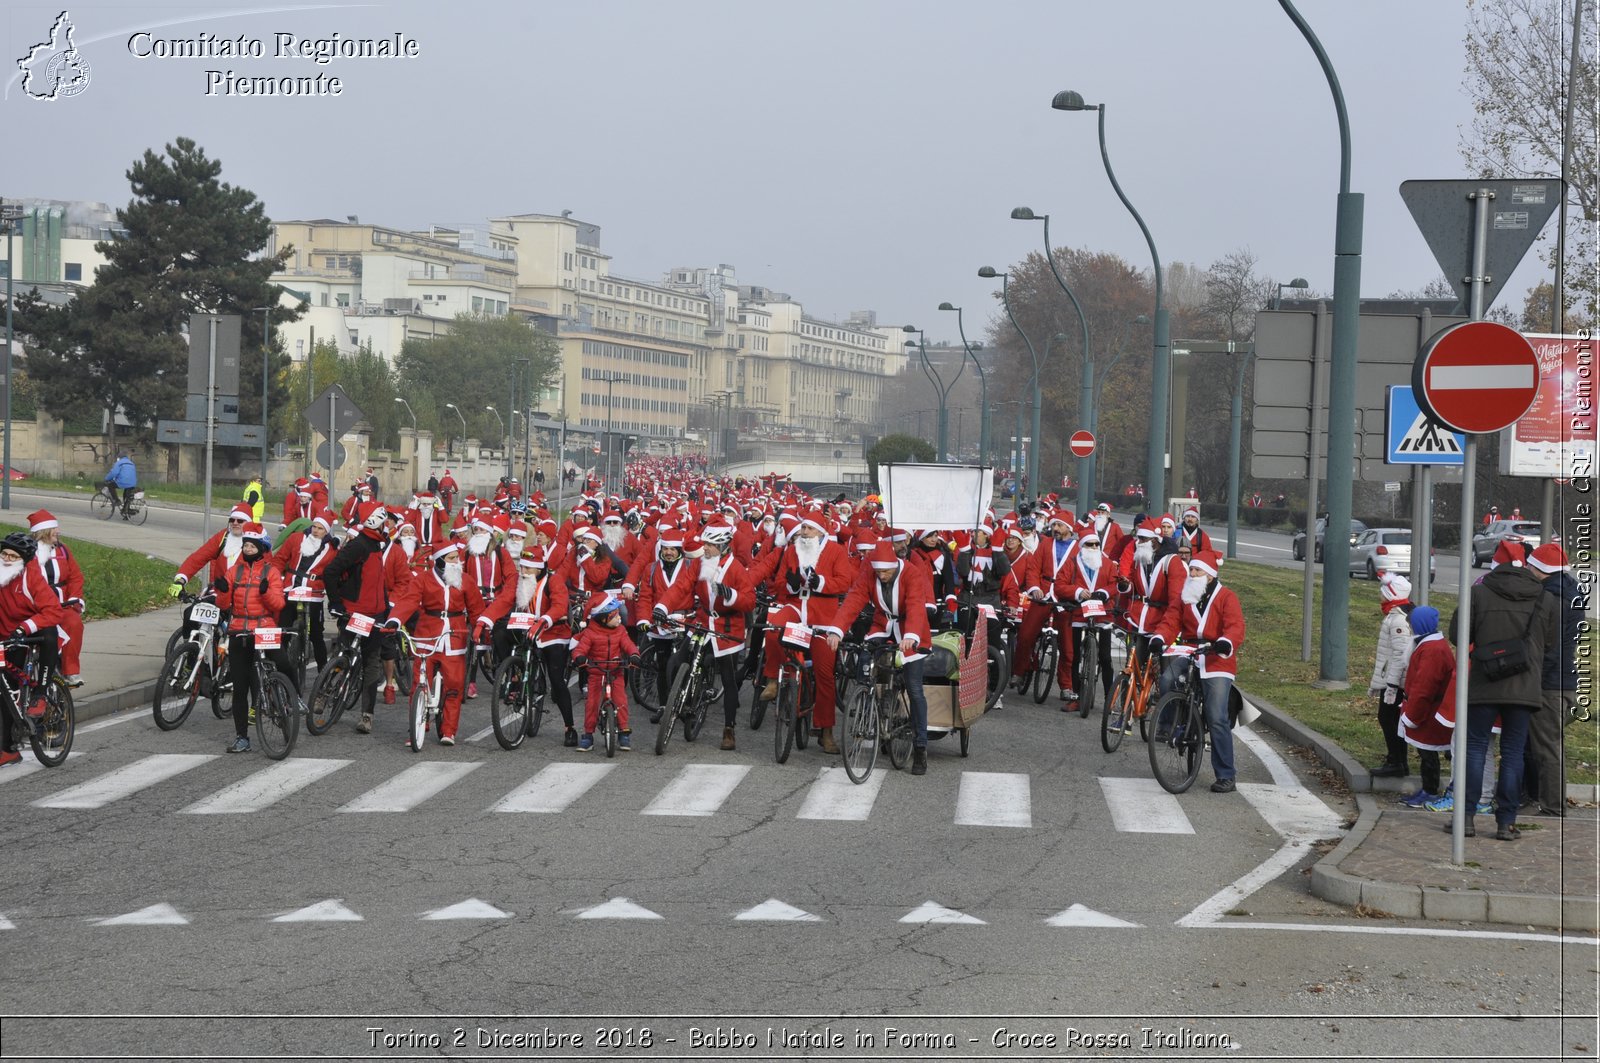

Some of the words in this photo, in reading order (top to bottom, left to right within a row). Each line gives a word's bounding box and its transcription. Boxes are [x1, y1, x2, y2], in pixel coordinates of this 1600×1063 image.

[1537, 343, 1570, 360] Natale
[1539, 358, 1565, 373] agico
[195, 608, 218, 619] 1705
